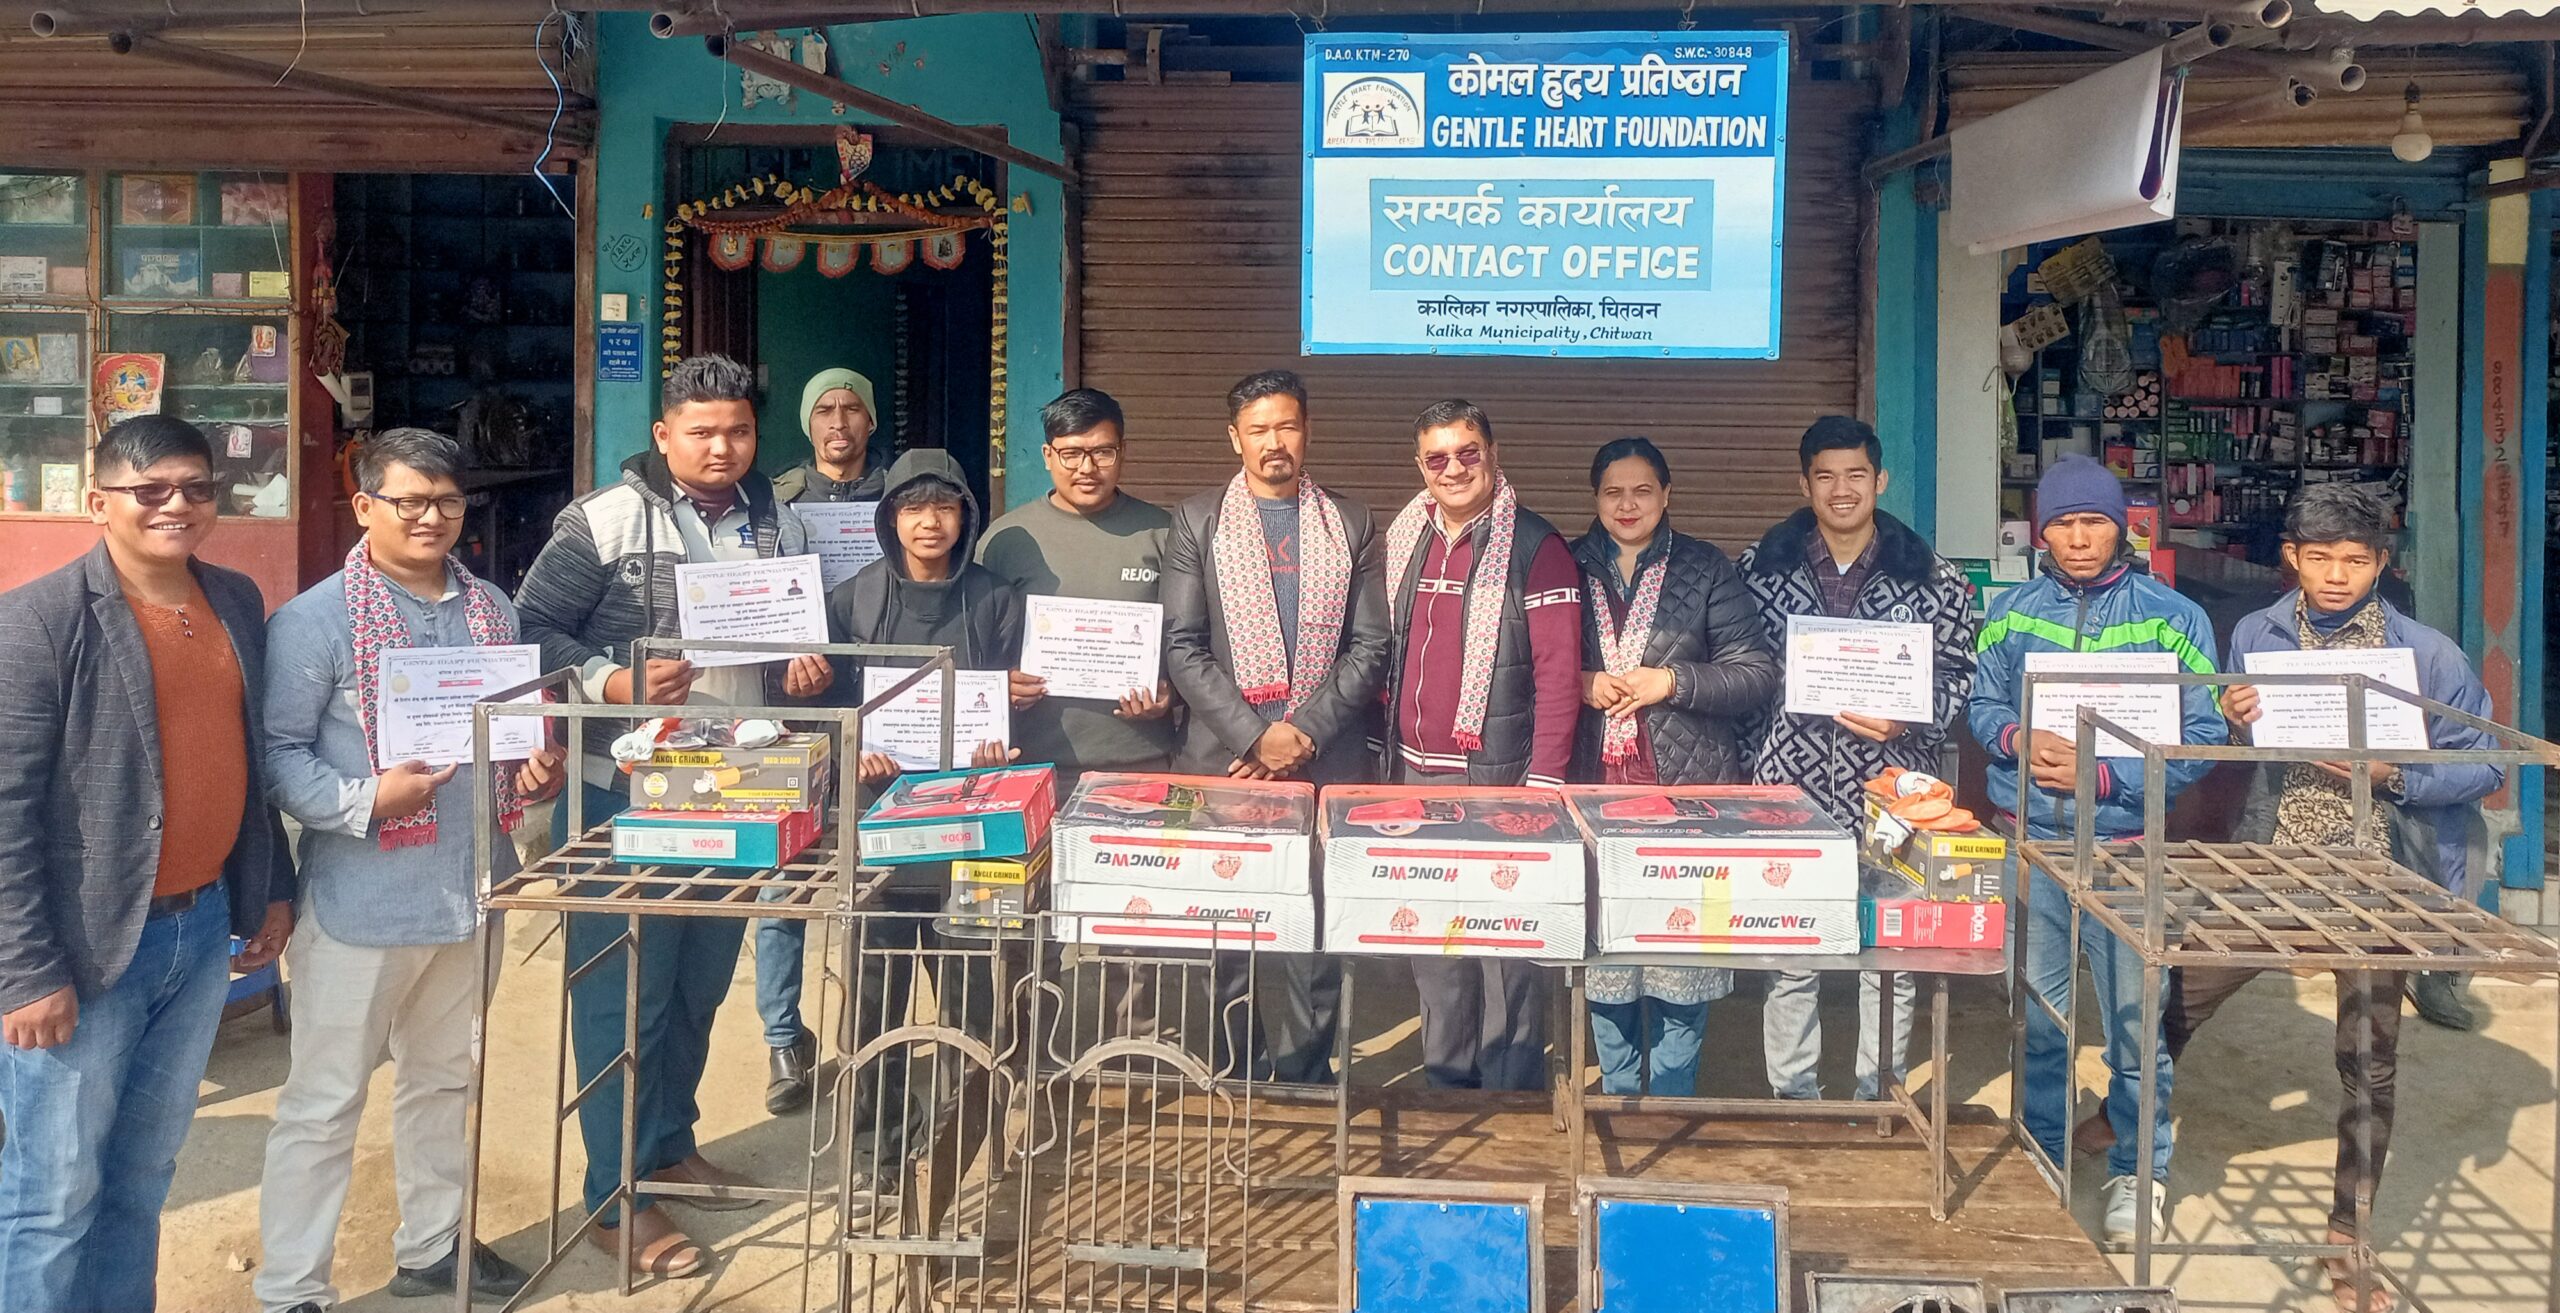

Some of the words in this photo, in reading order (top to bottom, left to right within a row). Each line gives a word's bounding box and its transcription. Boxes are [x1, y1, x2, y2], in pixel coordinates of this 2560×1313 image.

[1325, 49, 1353, 61] D.A.O.
[1356, 49, 1410, 61] KTM-270
[1448, 53, 1539, 98] कोमल
[1542, 63, 1614, 108] हृदय
[1620, 53, 1747, 97] प्रतिष्ठान
[1432, 115, 1525, 150] GENTLE
[1534, 115, 1608, 149] HEART
[1615, 114, 1768, 149] FOUNDATION
[1382, 183, 1504, 231] सम्पर्क
[1518, 185, 1694, 231] कार्यालय
[1382, 243, 1549, 279] CONTACT
[1563, 245, 1700, 279] OFFICE
[1417, 294, 1490, 319] कालिका
[1600, 295, 1661, 320] चितवन
[1425, 323, 1474, 339] Kalika
[1590, 326, 1654, 341] Chitwan
[655, 755, 678, 764] ANGLE
[678, 755, 710, 765] GRINDER
[693, 838, 724, 849] BODA
[940, 832, 973, 842] BODA
[1954, 845, 1974, 854] ANGLE
[1975, 846, 2002, 855] GRINDER
[973, 870, 992, 879] ANGLE
[993, 871, 1020, 880] GRINDER
[1971, 905, 1988, 942] BODA
